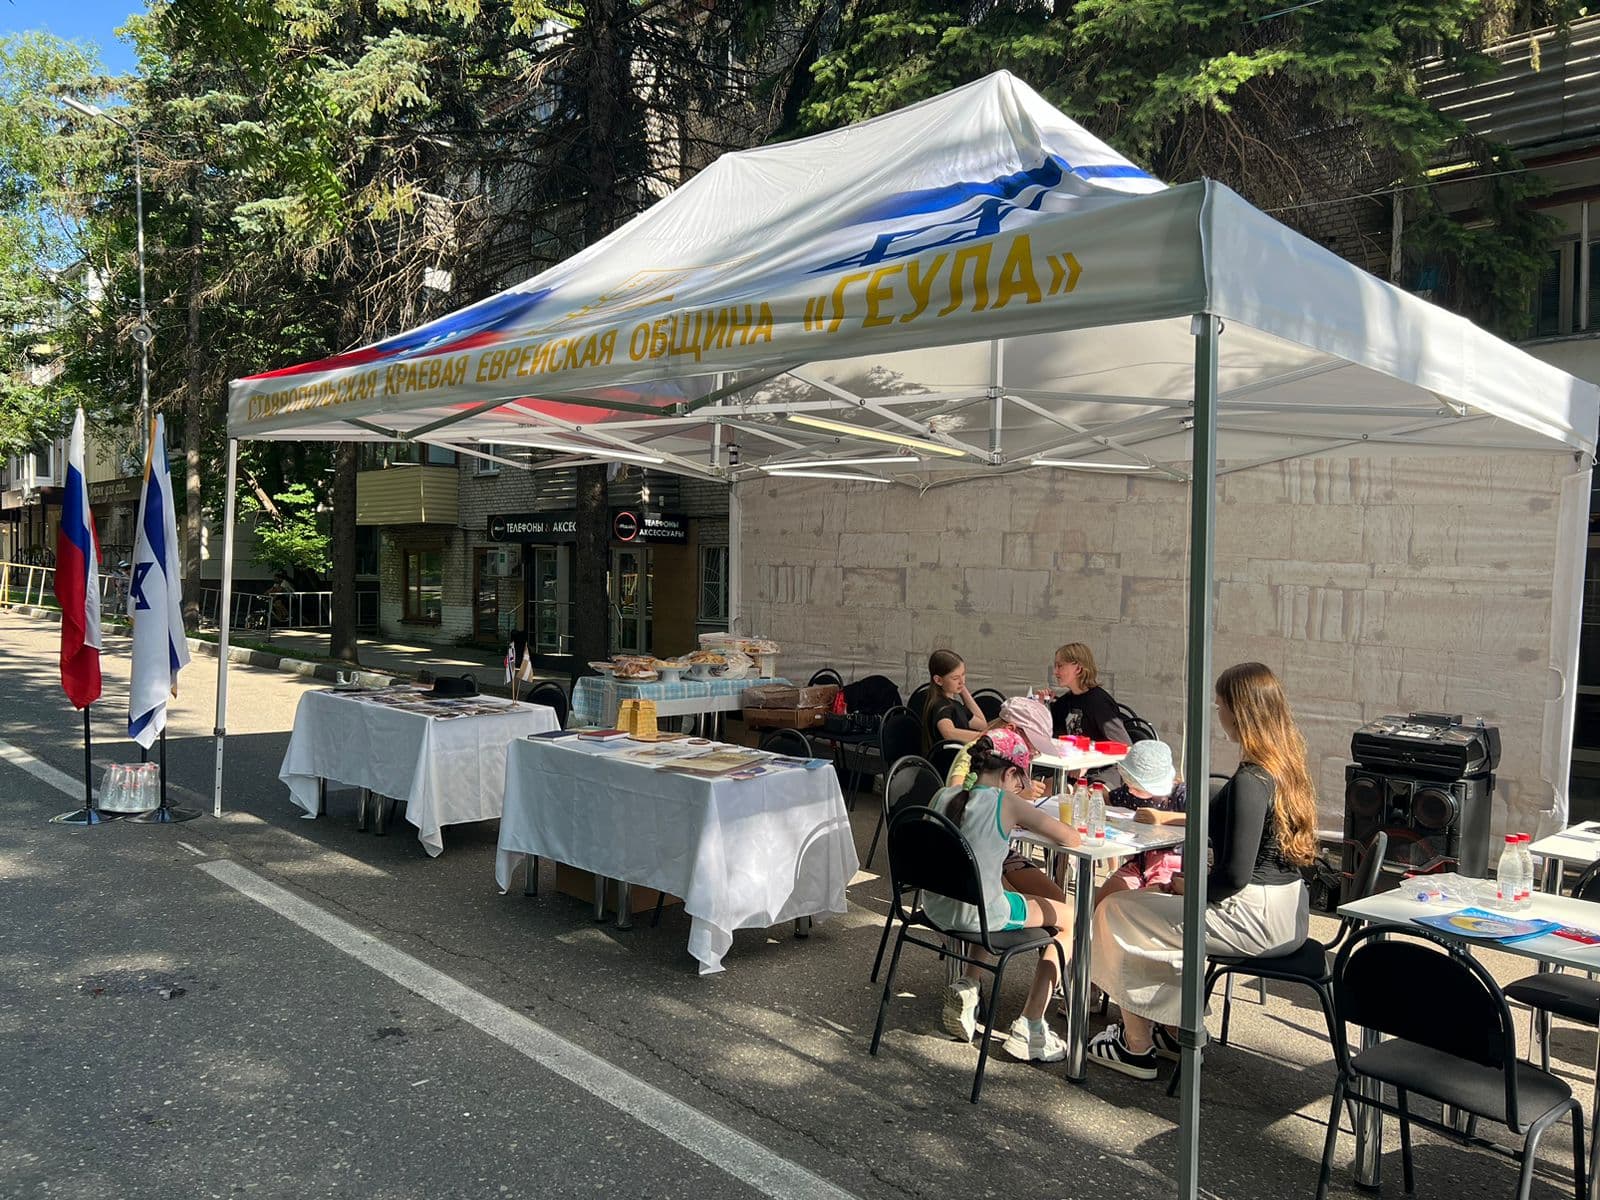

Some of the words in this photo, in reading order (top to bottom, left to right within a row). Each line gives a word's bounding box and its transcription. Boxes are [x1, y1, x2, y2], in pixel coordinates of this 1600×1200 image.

[247, 369, 378, 421] СТАВРОПОЛЬСКАЯ
[384, 354, 470, 396] КРАЕВАЯ
[629, 301, 773, 364] ОБЩИНА
[803, 233, 1083, 334] «ГЕУЛА»
[506, 522, 544, 533] ТЕЛЕФОНЫ
[644, 519, 679, 528] ТЕЛЕФОНЫ
[639, 528, 685, 537] АКСЕССУАРЫ
